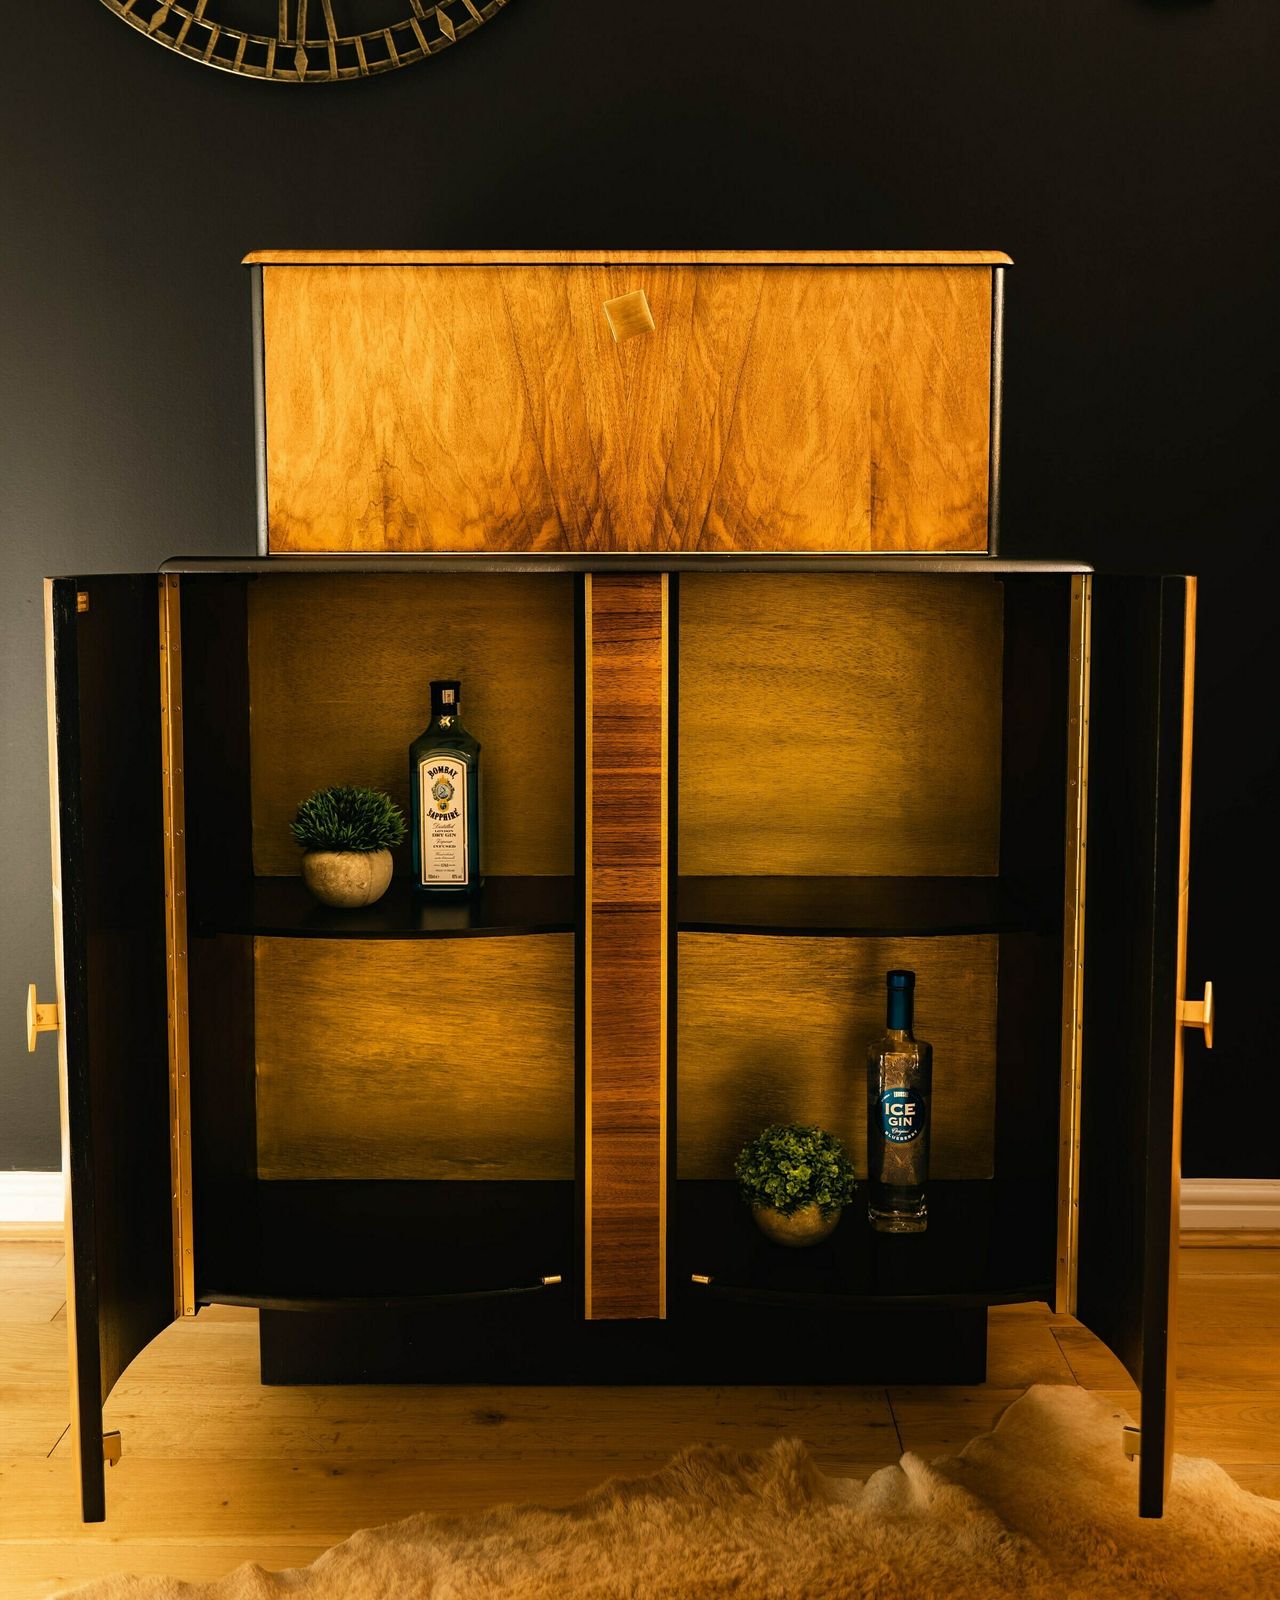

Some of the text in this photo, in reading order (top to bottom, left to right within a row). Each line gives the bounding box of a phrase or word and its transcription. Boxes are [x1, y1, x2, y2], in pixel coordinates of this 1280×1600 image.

[427, 765, 458, 779] BOMBAY
[427, 807, 460, 821] SAPPHIRE
[885, 1103, 916, 1116] ICE
[888, 1117, 912, 1126] GIN
